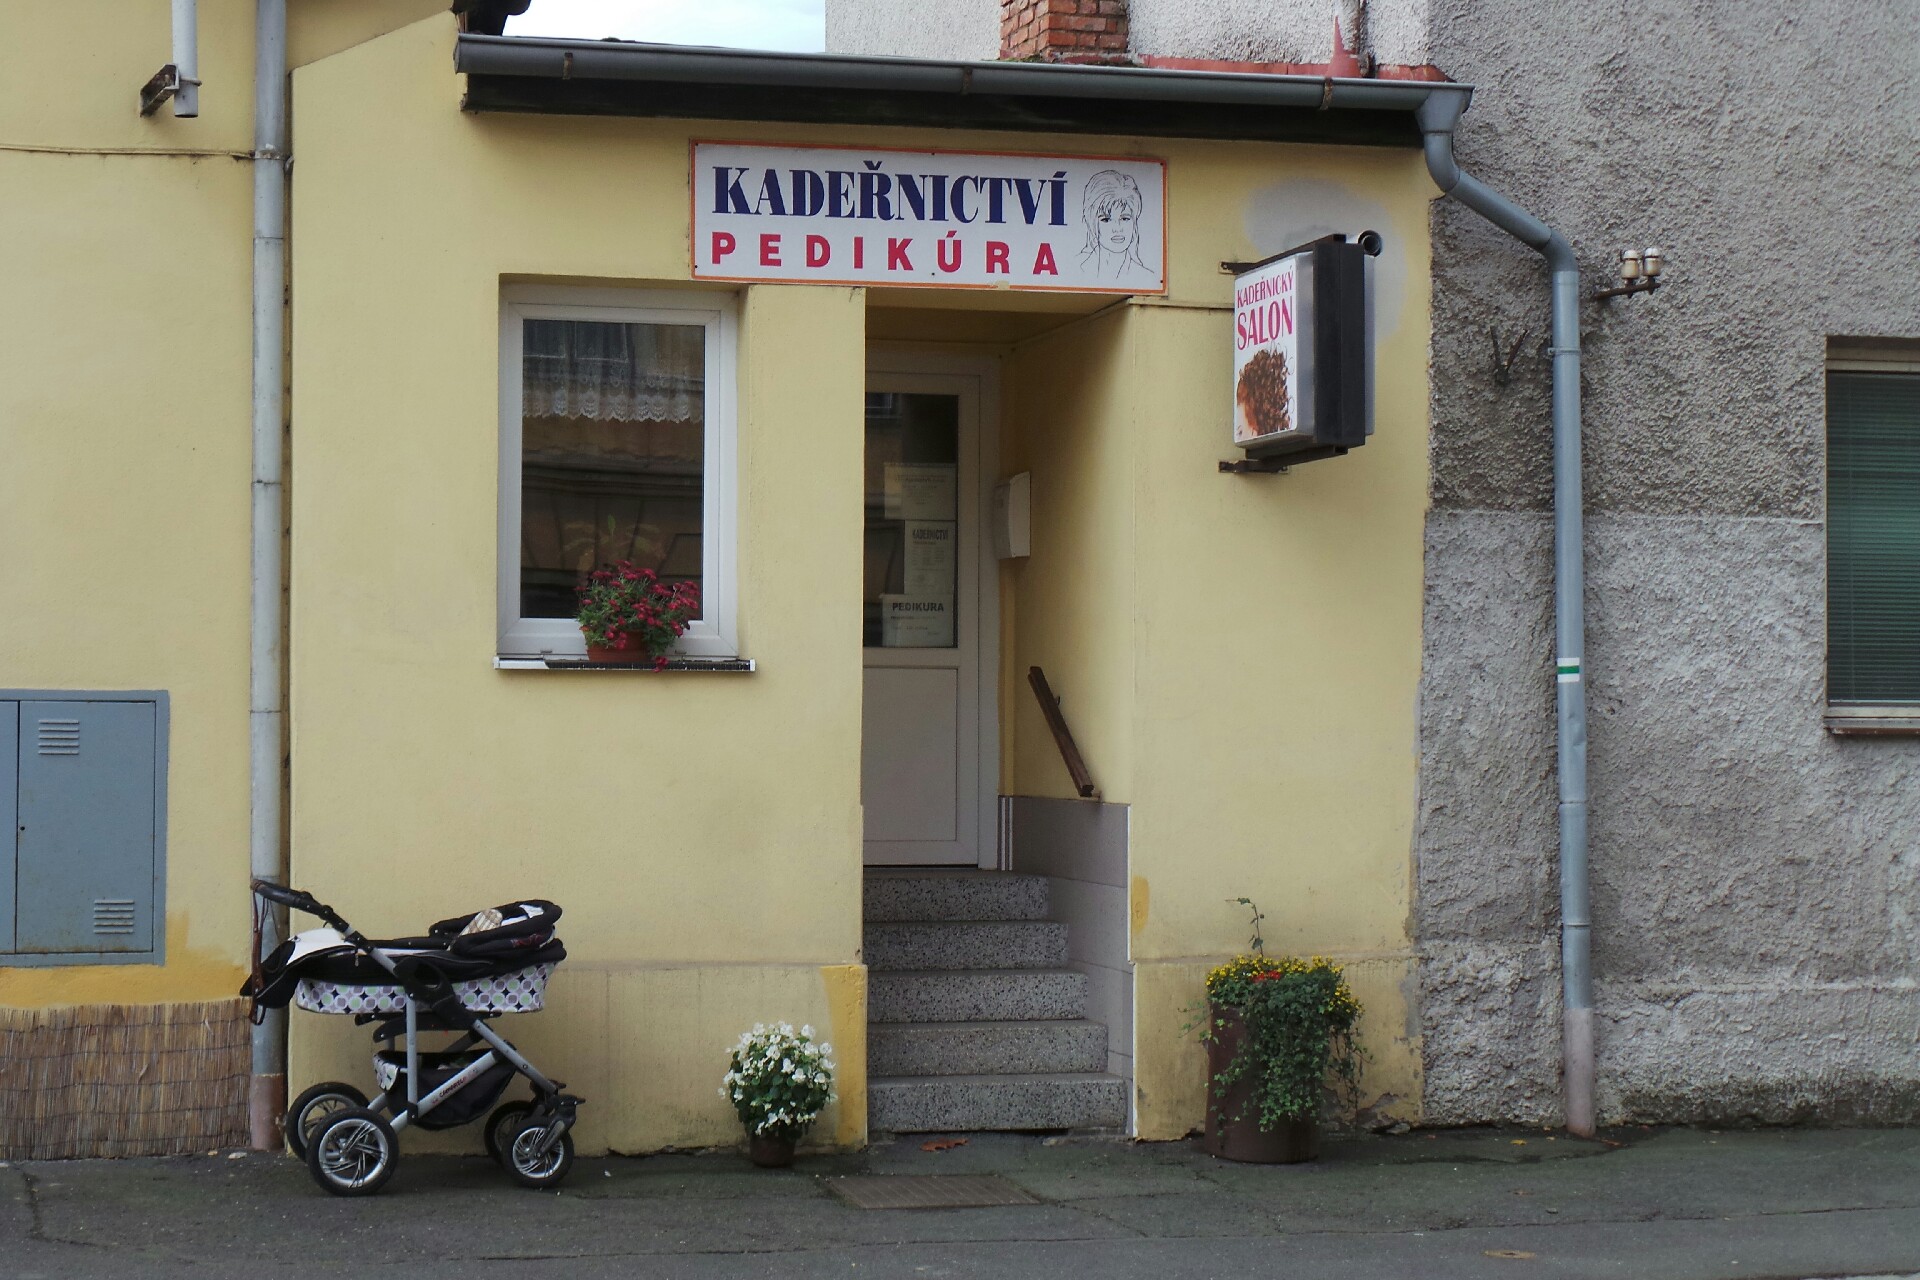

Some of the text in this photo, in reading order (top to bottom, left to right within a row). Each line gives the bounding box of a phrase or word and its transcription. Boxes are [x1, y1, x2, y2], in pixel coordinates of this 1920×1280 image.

[712, 160, 1068, 226] KADEŘNICTVÍ
[711, 230, 1059, 275] PEDIKÚRA
[1237, 265, 1294, 308] KADEŘNICKÝ
[1237, 296, 1293, 351] SALON
